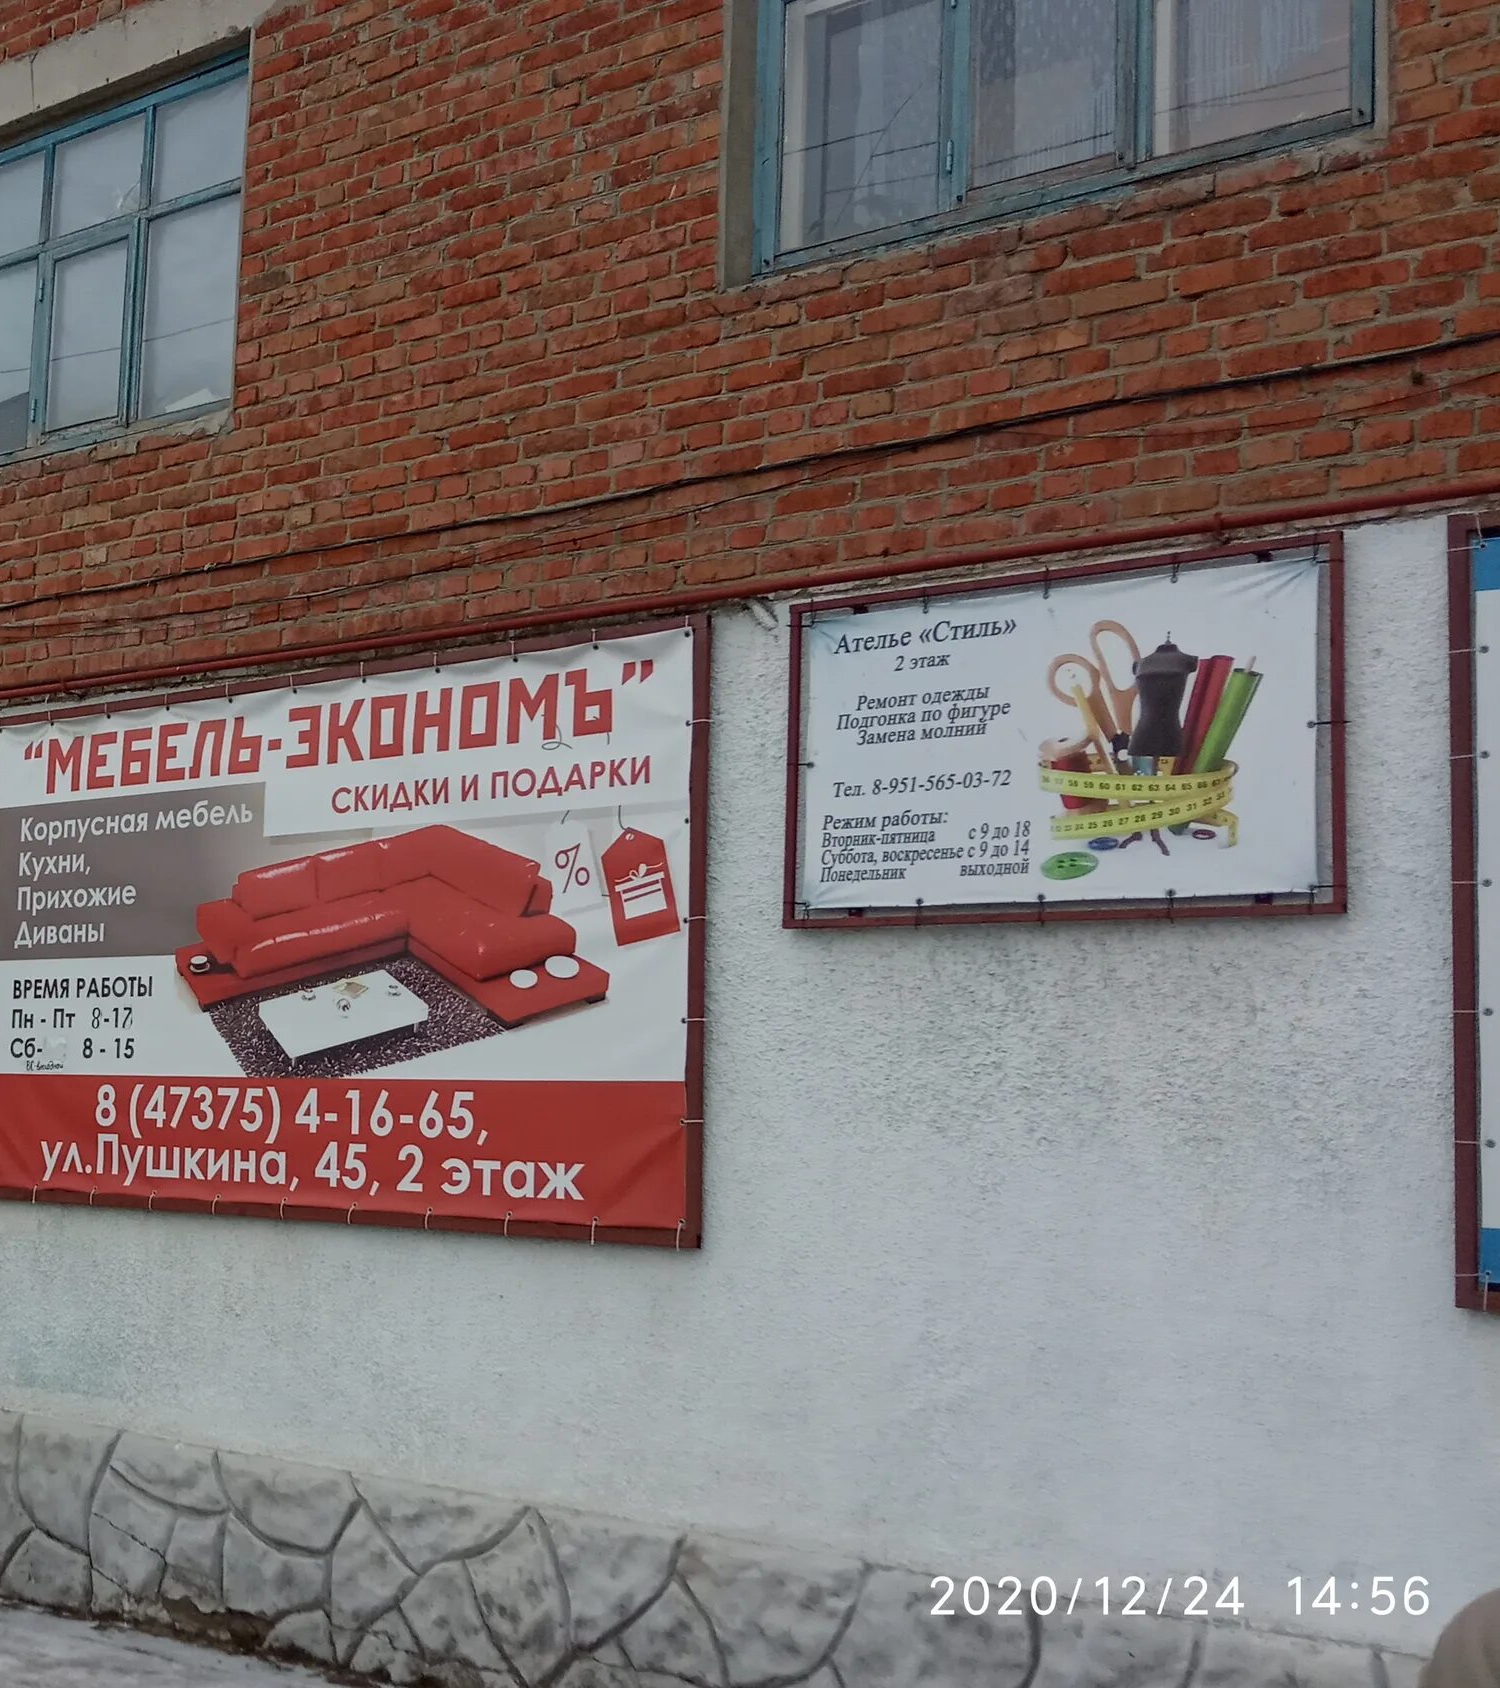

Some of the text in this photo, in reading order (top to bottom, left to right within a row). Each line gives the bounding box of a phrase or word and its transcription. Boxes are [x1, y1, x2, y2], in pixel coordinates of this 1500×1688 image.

[834, 618, 1017, 655] Ателье «Стиль»
[894, 653, 951, 672] 2 этаж
[855, 686, 990, 712] Ремонт одежды
[836, 701, 1011, 731] Подгонка по фигуре
[856, 717, 988, 746] Замена молний
[330, 754, 652, 815] СКИДКИ И ПОДАРКИ
[833, 769, 1012, 798] Тел. 8-951-565-03-72
[18, 801, 254, 847] Корпусная мебель
[821, 809, 949, 832] Режим работы:
[1118, 817, 1129, 825] 27
[1151, 811, 1163, 820] 29
[1169, 807, 1180, 815] 30
[821, 829, 936, 850] Вторник-пятница
[967, 827, 977, 840] с
[980, 822, 990, 840] 9
[991, 825, 1010, 842] до
[1014, 820, 1031, 838] 18
[17, 850, 92, 879] Кухни,
[821, 839, 1030, 869] Суббота, воскресенье с 9 до 14
[820, 858, 1030, 883] Понедельник выходной
[15, 883, 137, 914] Прихожие
[13, 918, 106, 949] Диваны
[12, 975, 153, 999] ВРЕМЯ РАБОТЫ
[11, 1008, 34, 1029] Пн
[53, 1008, 76, 1029] Пт
[82, 1037, 93, 1059] 8
[114, 1037, 135, 1059] 15
[94, 1082, 490, 1147] 8 (47375) 4-16-65,
[314, 1140, 382, 1198] 45,
[396, 1144, 425, 1193] 2
[440, 1155, 587, 1202] этаж
